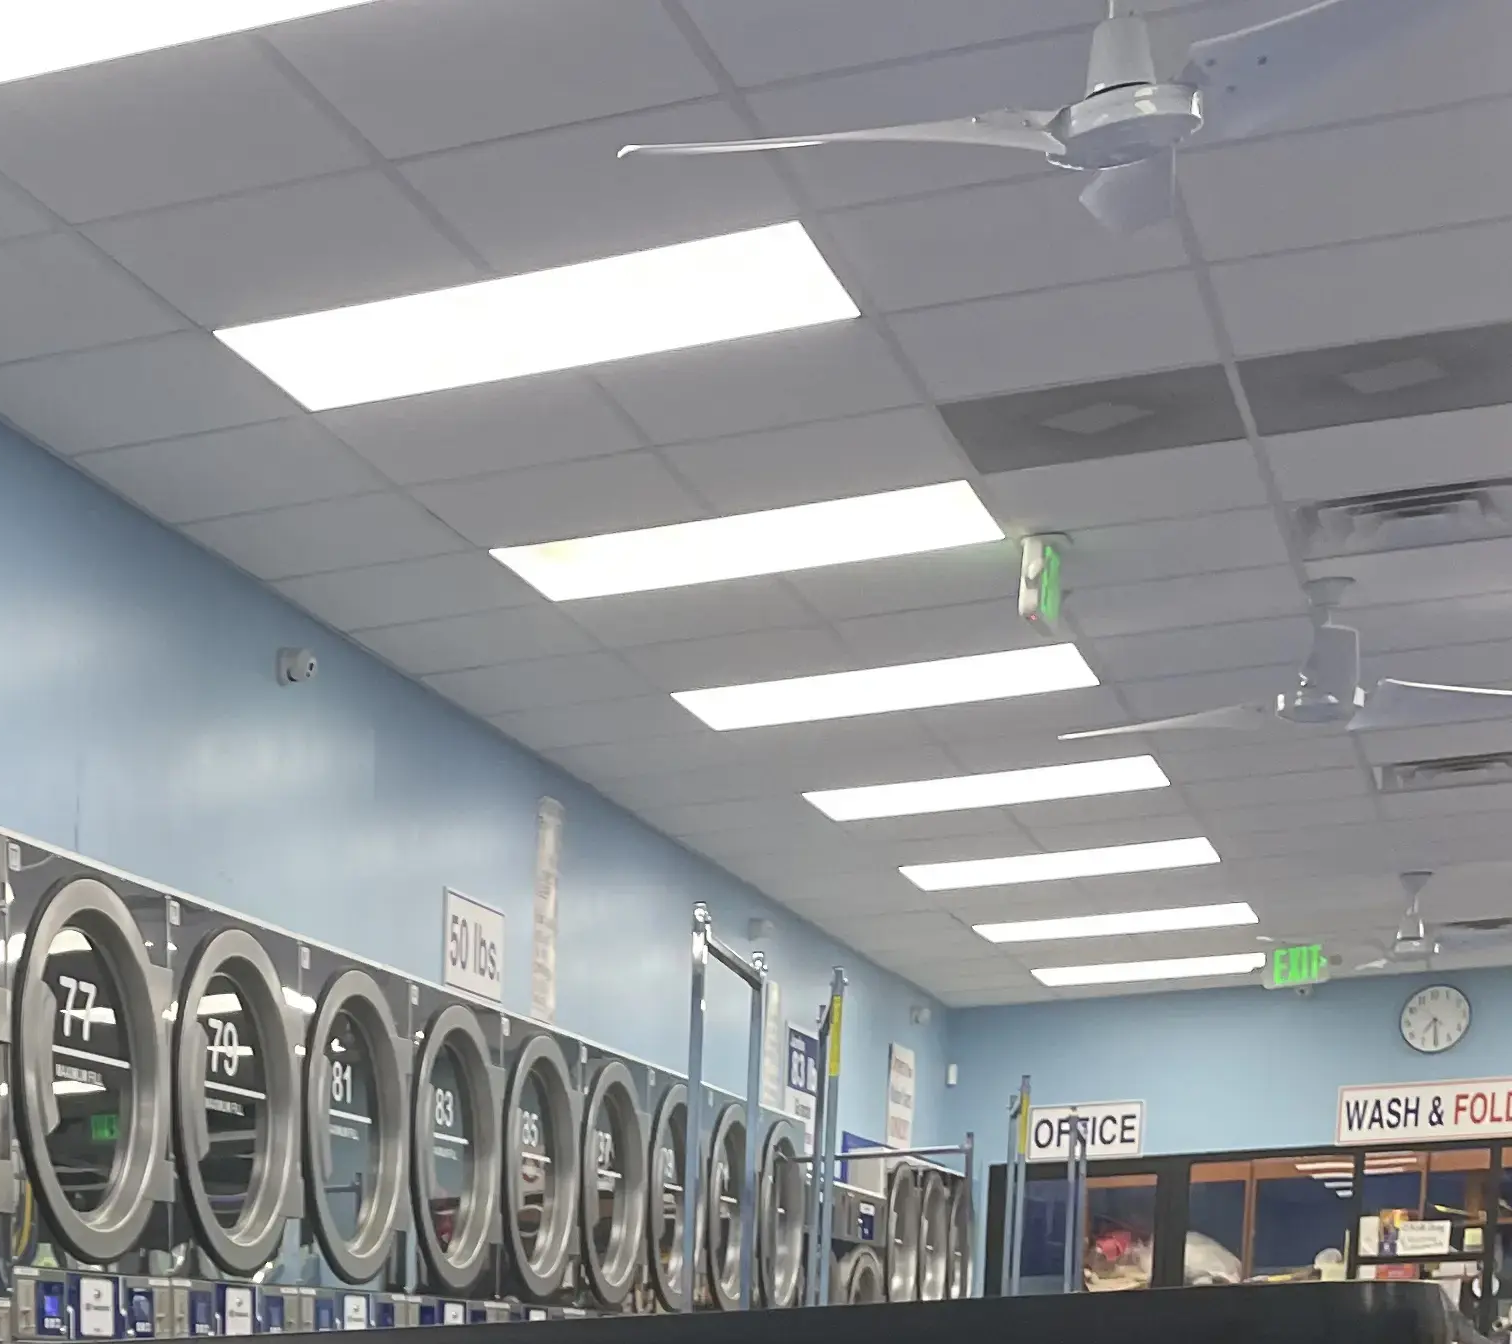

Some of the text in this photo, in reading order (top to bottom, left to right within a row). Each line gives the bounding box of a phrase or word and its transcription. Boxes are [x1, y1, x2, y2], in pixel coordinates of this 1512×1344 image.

[450, 915, 500, 982] 50 lbs.
[1273, 944, 1321, 985] EXIT
[59, 975, 97, 1041] 77
[208, 1018, 238, 1076] 79
[332, 1061, 352, 1104] 81
[435, 1088, 454, 1127] 83
[1346, 1096, 1420, 1131] WASH
[1428, 1096, 1444, 1127] &
